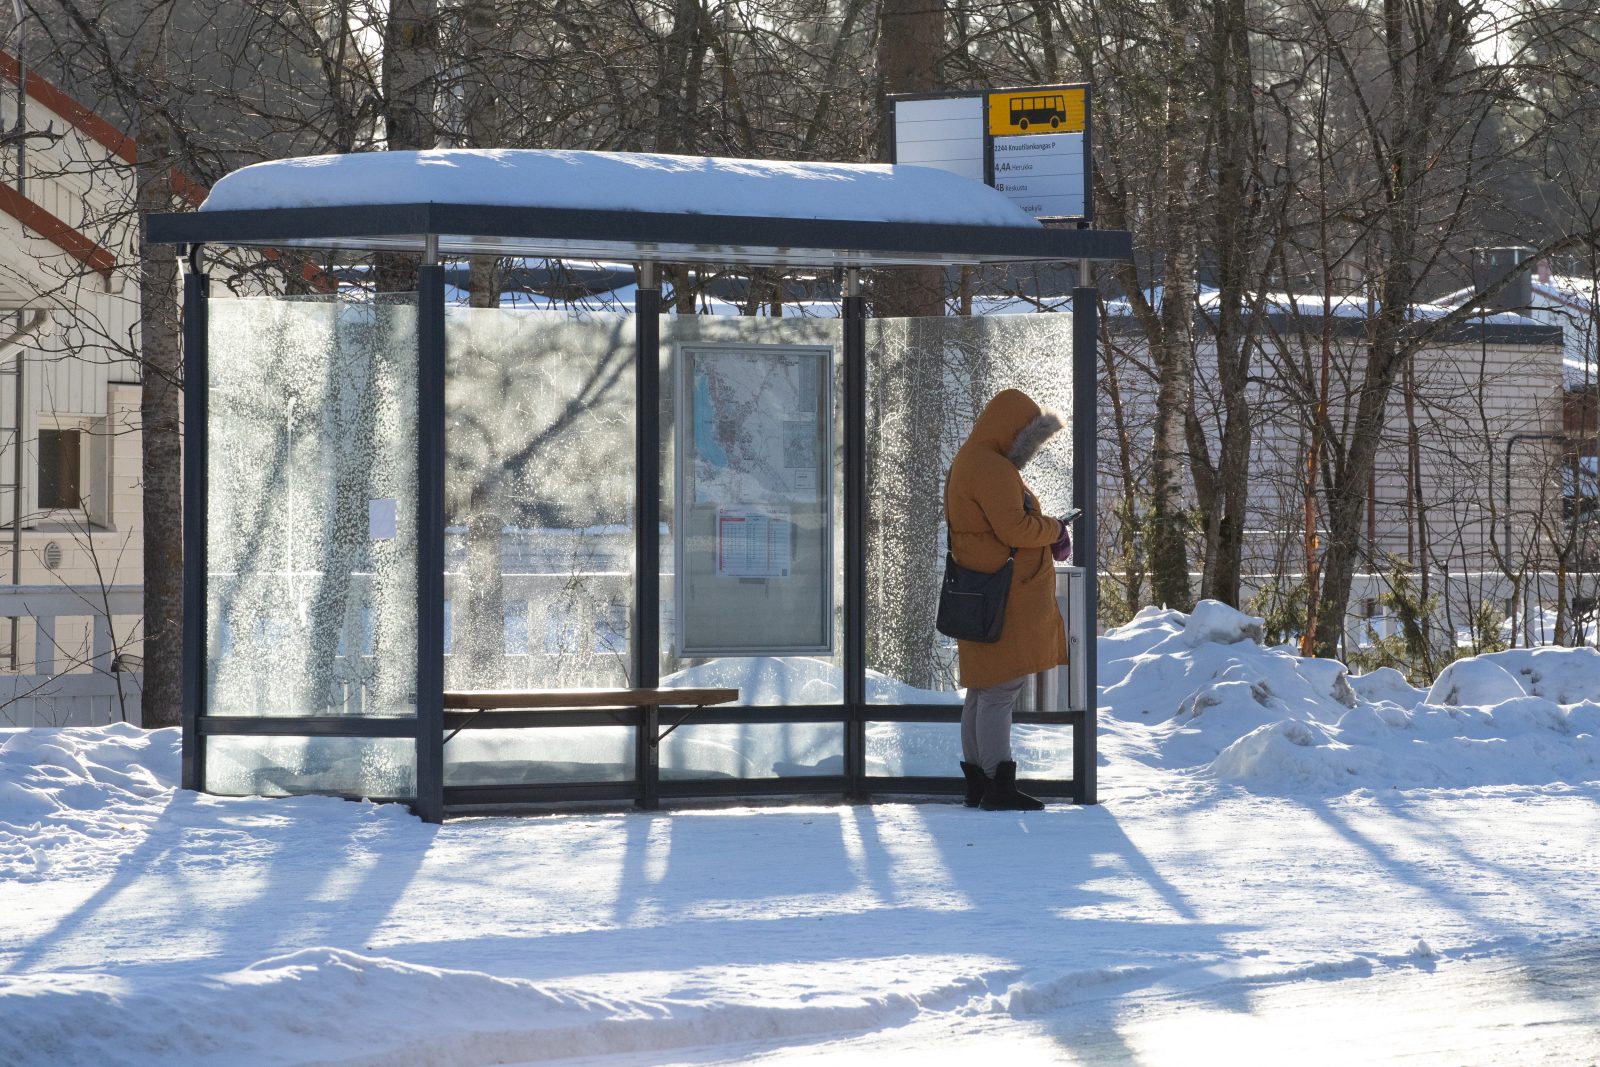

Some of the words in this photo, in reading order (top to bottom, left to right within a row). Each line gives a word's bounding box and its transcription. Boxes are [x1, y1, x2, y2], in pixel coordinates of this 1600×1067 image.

[1008, 143, 1051, 151] Knuutilankangas
[994, 162, 1010, 172] 4,4A
[995, 184, 1004, 192] 4B
